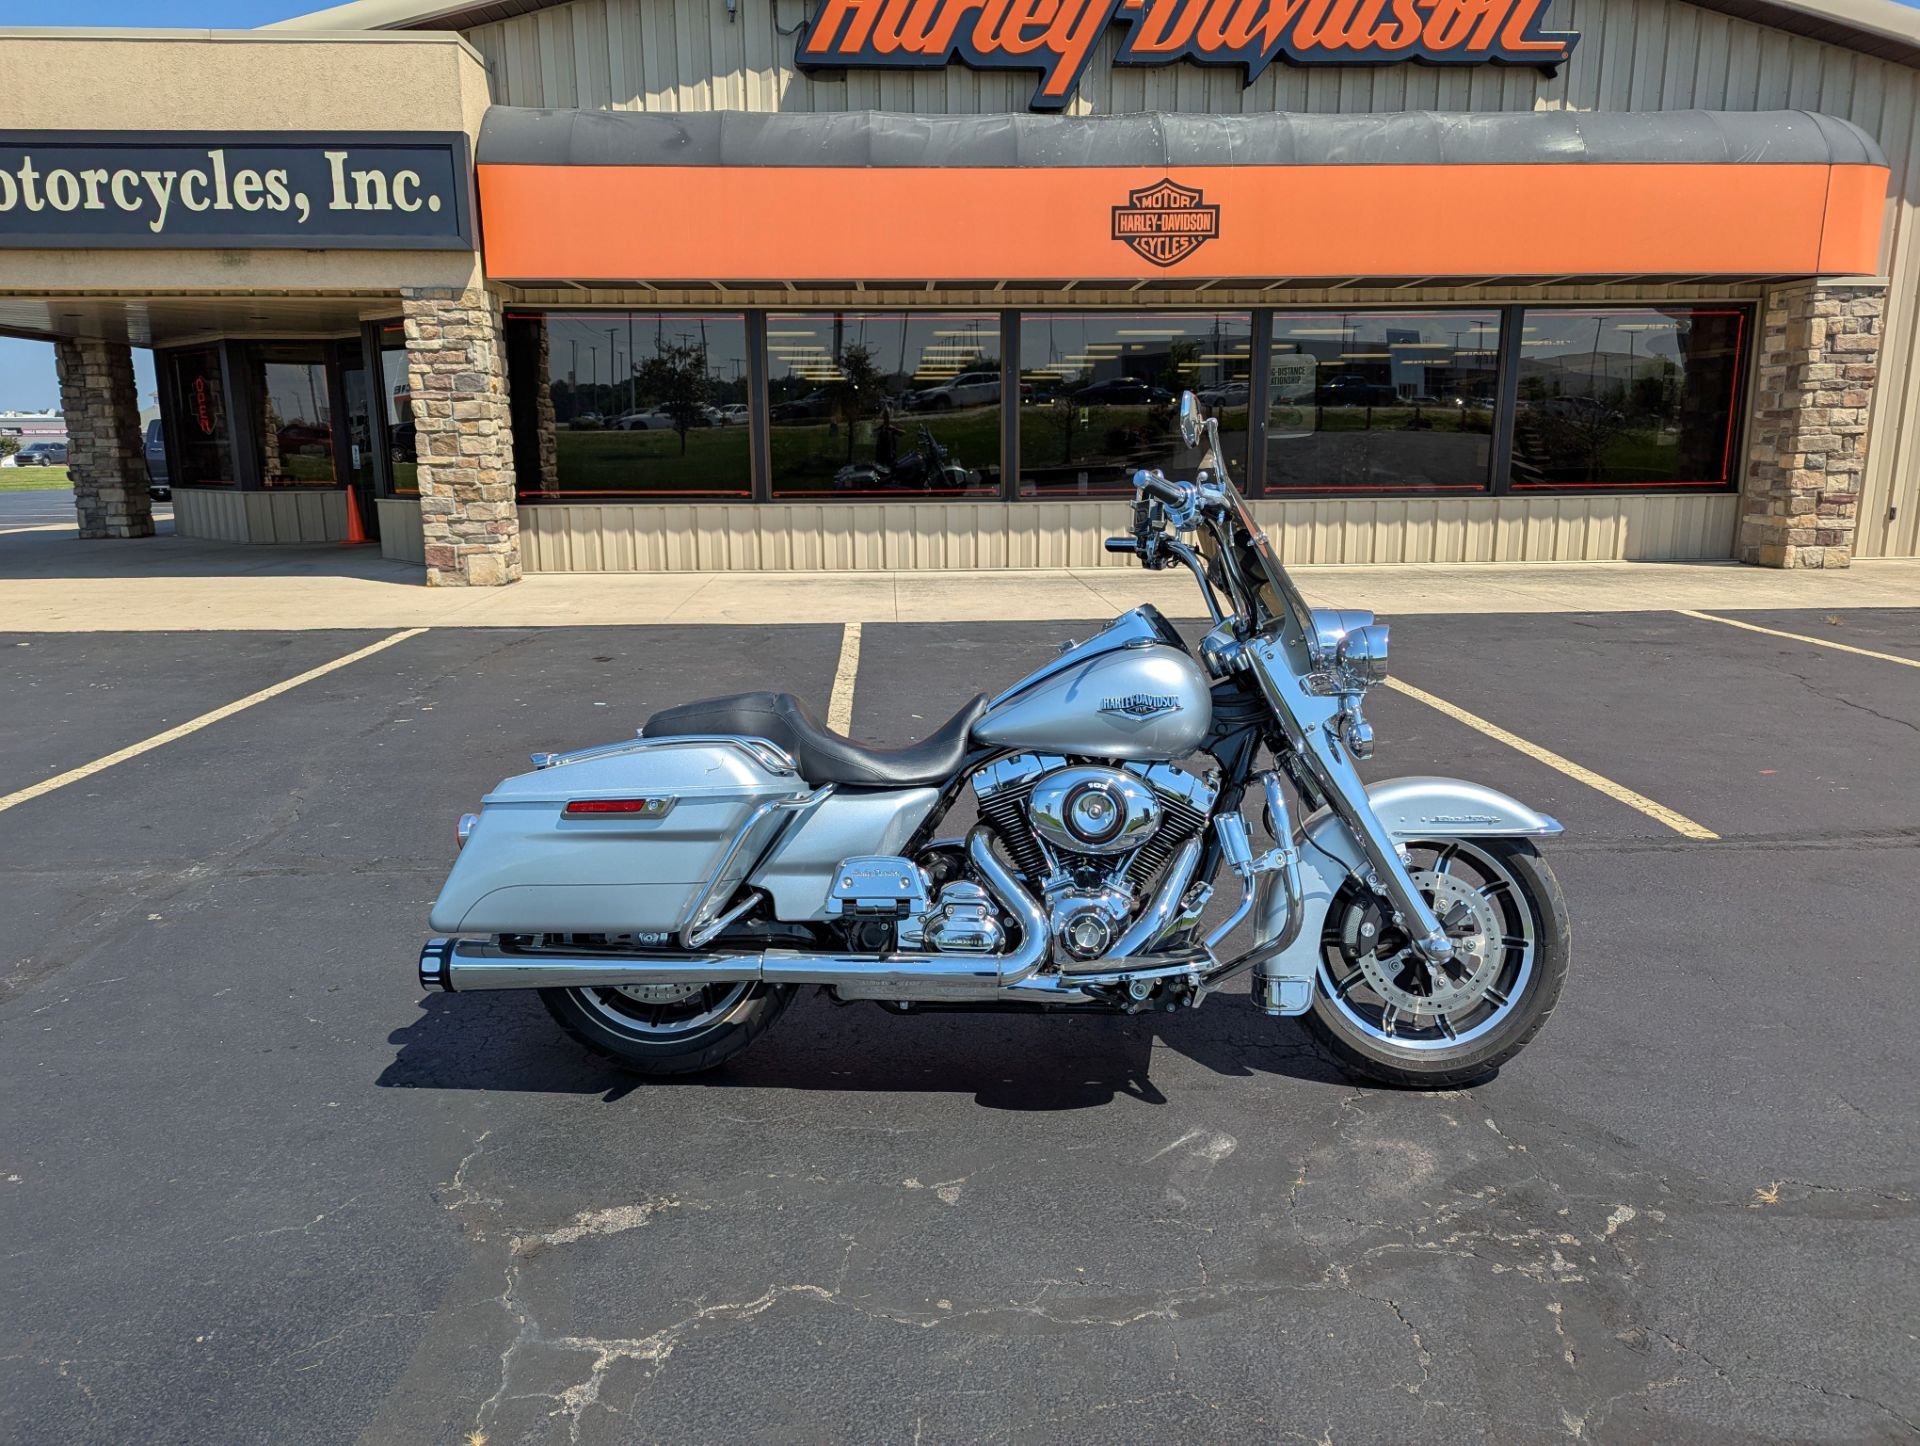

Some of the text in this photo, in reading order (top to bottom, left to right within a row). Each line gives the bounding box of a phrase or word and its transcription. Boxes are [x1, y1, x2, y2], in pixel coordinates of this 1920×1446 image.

[325, 151, 441, 213] Inc.
[1141, 188, 1190, 208] MOTOR
[1120, 213, 1211, 232] HARLEY-DAVIDSON
[1140, 236, 1189, 259] CYCLES
[196, 378, 212, 433] OPEN
